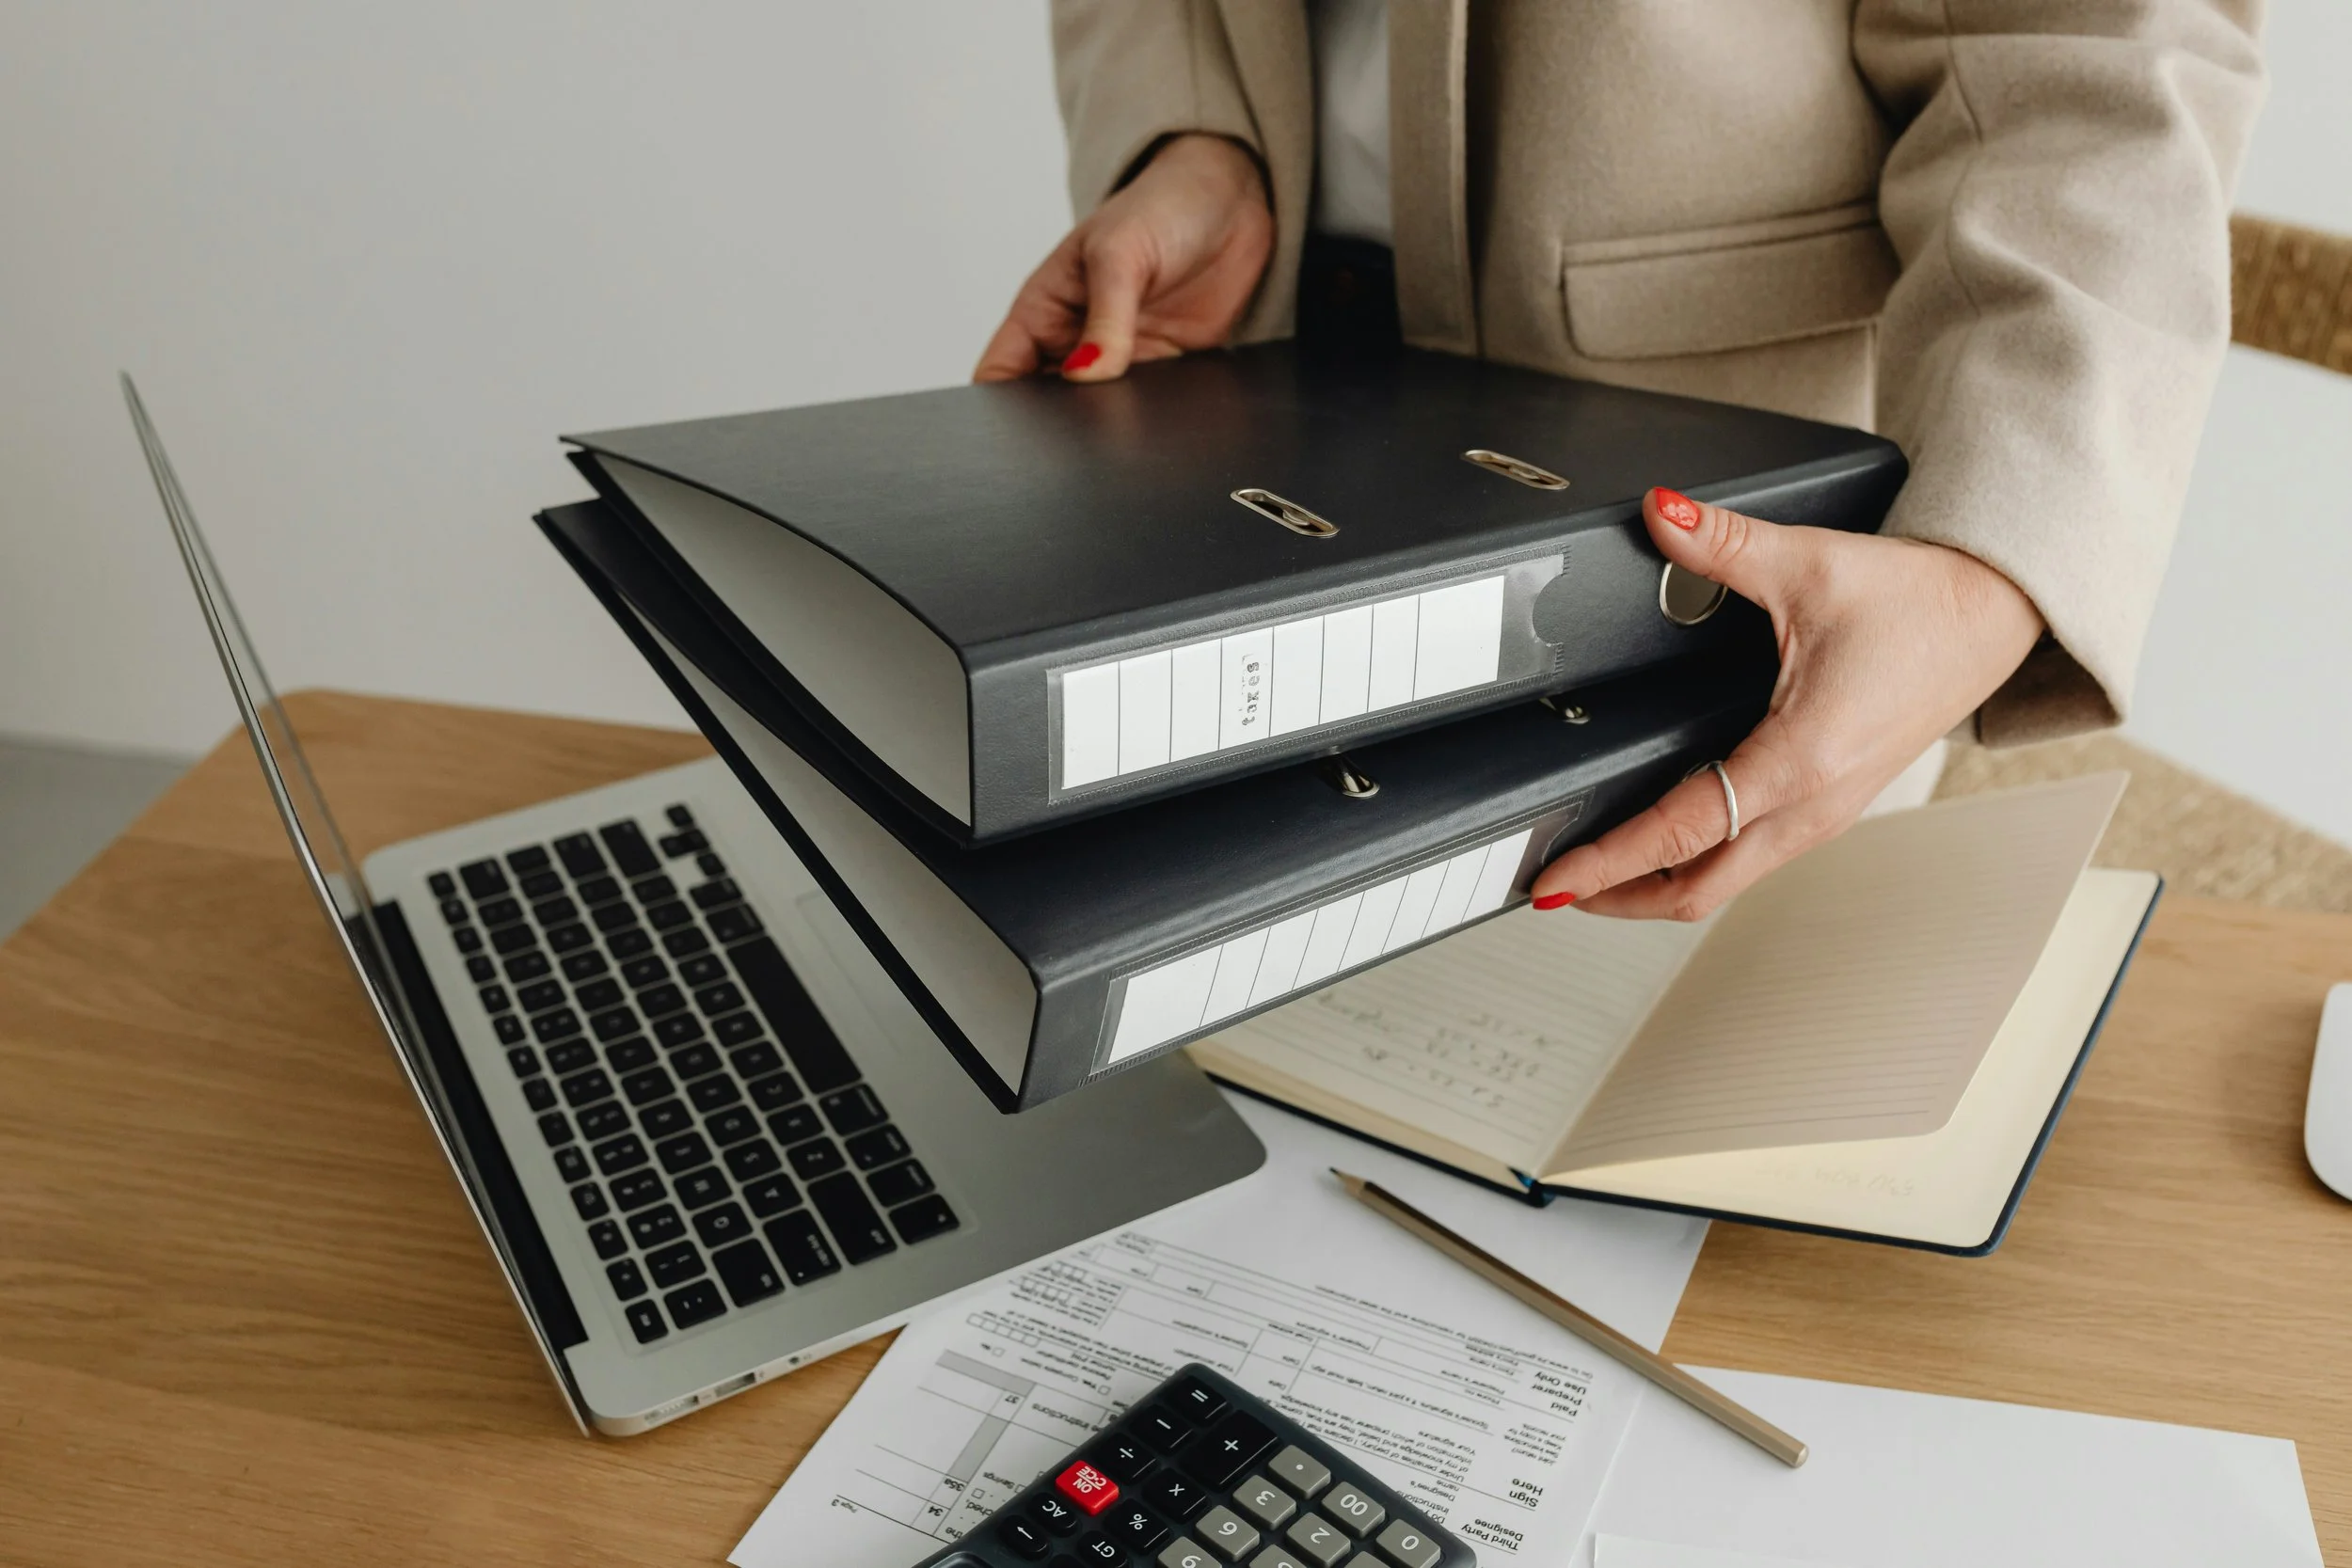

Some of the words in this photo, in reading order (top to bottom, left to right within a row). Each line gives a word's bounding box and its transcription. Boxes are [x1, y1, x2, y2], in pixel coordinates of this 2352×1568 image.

[1242, 662, 1260, 726] taxes
[1534, 1371, 1560, 1386] Only
[1532, 1384, 1582, 1406] Preparer
[1564, 1383, 1586, 1395] Use
[1005, 1395, 1019, 1404] 37
[1032, 1403, 1089, 1430] instructions
[1550, 1402, 1578, 1417] Paid
[944, 1479, 964, 1492] 35a
[983, 1472, 1015, 1489] Savings
[1072, 1478, 1094, 1495] ON
[1436, 1480, 1459, 1492] name
[1512, 1479, 1543, 1496] Here
[1257, 1491, 1275, 1505] 3
[1410, 1481, 1455, 1502] Designee's
[1509, 1491, 1538, 1507] Sign
[831, 1498, 839, 1507] 3
[840, 1502, 856, 1513] Page
[1043, 1501, 1066, 1516] AC
[1341, 1495, 1368, 1515] 00
[928, 1506, 943, 1516] 34
[1219, 1522, 1237, 1535] 6
[1311, 1528, 1329, 1543] 2
[1461, 1524, 1489, 1541] Party
[1474, 1519, 1523, 1542] Designee
[1092, 1542, 1114, 1557] GT
[1402, 1536, 1419, 1549] 0
[1490, 1535, 1518, 1551] Third
